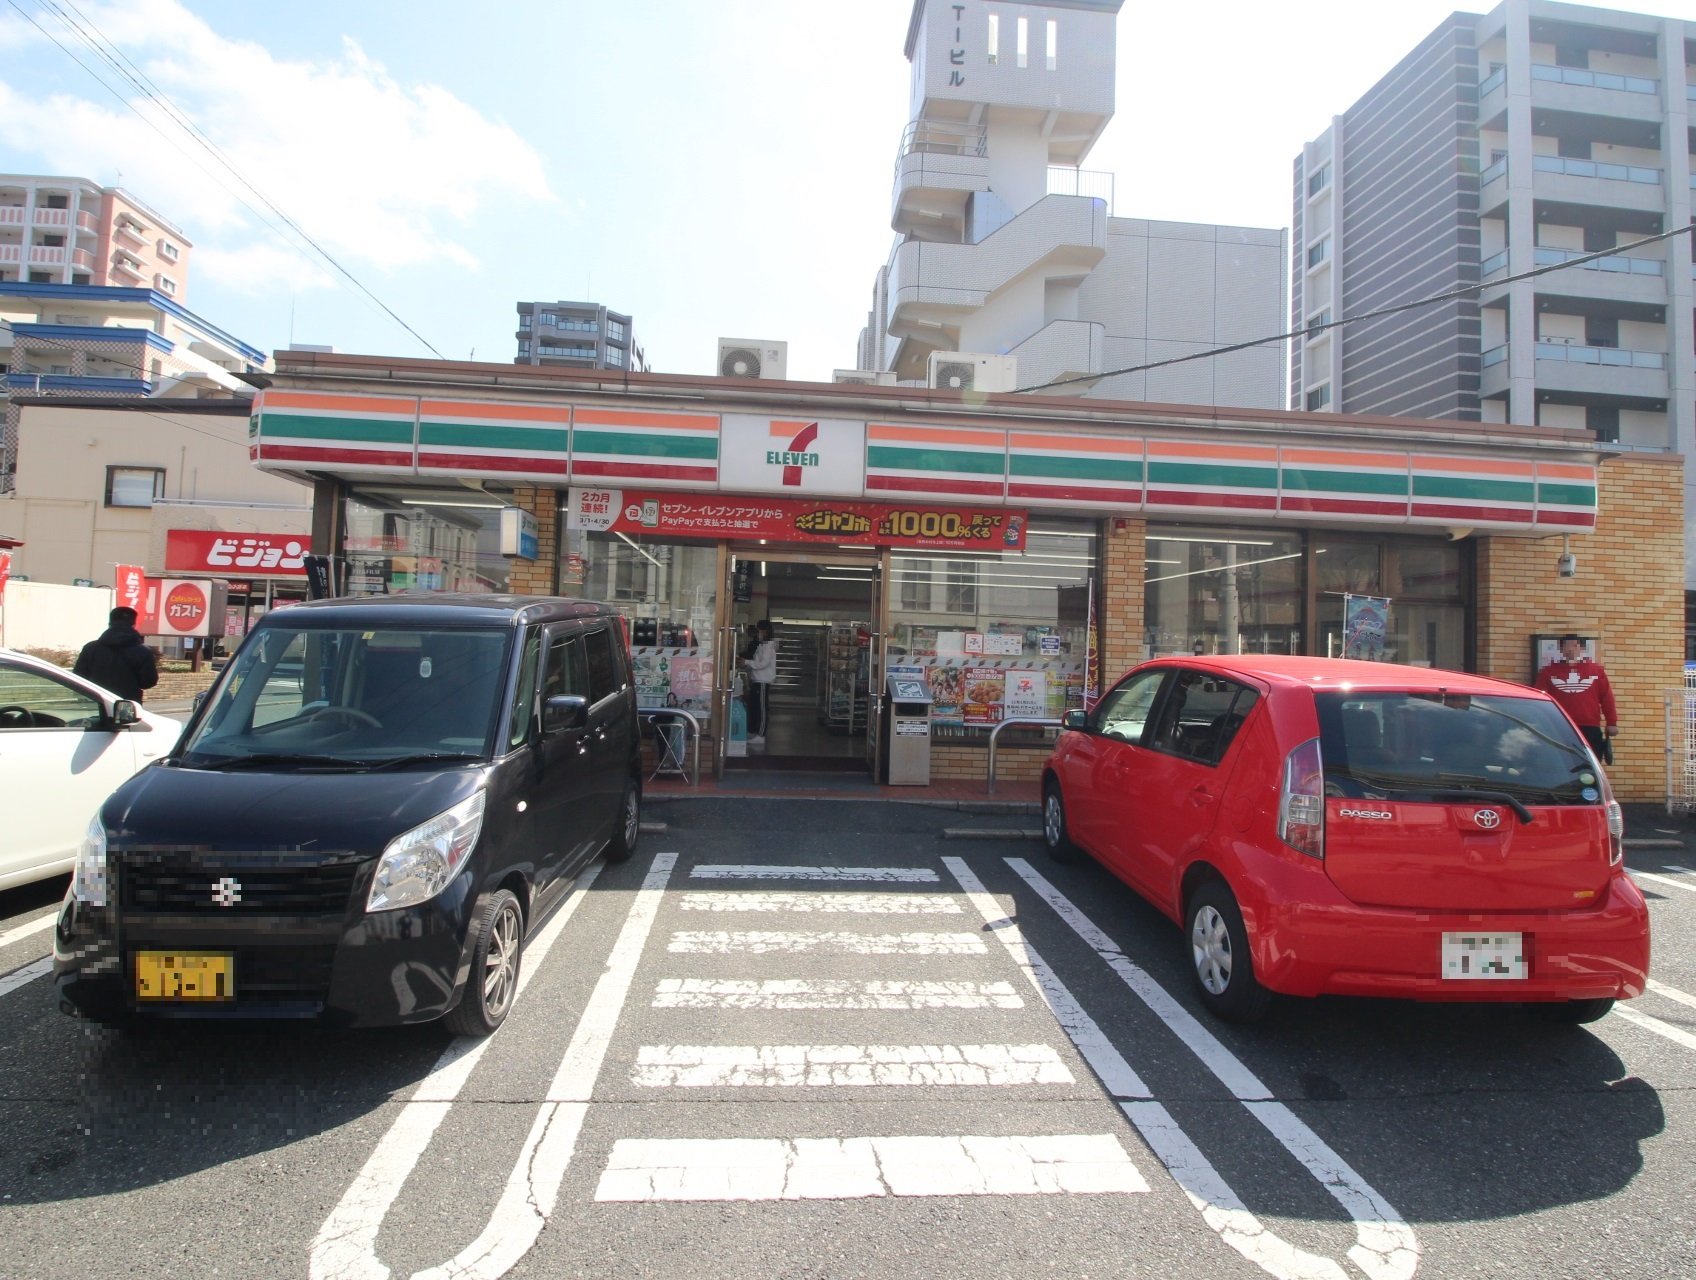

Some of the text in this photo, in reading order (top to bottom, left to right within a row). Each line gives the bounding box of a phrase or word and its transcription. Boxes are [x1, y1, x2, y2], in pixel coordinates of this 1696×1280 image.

[815, 510, 871, 532] ジャンボ
[972, 514, 1002, 526] 戻って
[972, 527, 991, 537] くる
[207, 538, 310, 569] ビジョン
[169, 604, 202, 617] ガスト
[1340, 809, 1392, 819] PASSO
